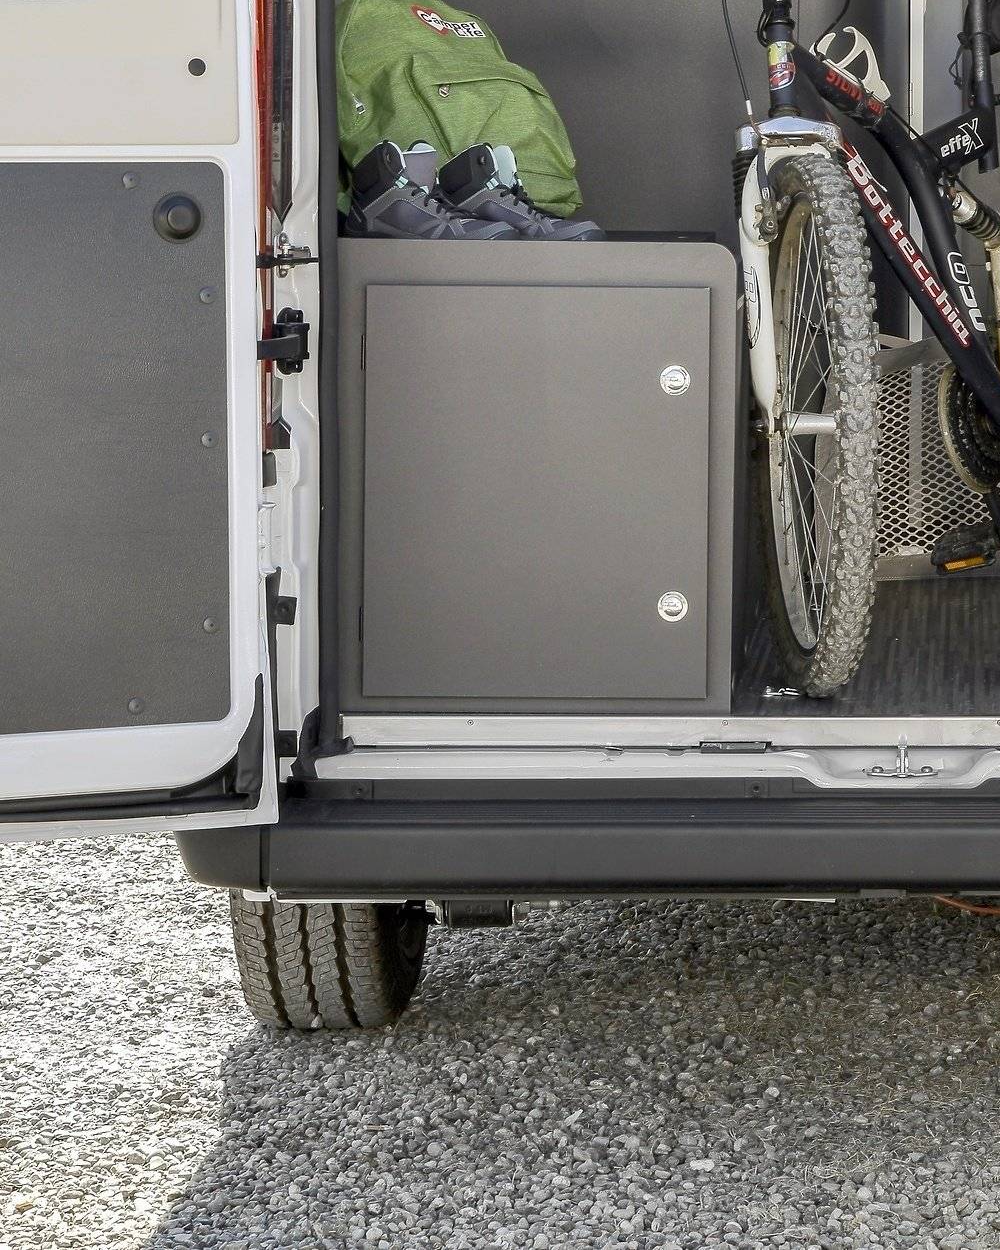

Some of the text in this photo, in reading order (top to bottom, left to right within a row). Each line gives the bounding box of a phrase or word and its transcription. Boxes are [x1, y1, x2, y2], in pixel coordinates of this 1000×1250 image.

[456, 28, 484, 37] Life
[940, 117, 984, 157] effeX
[846, 146, 971, 346] Bottecchia
